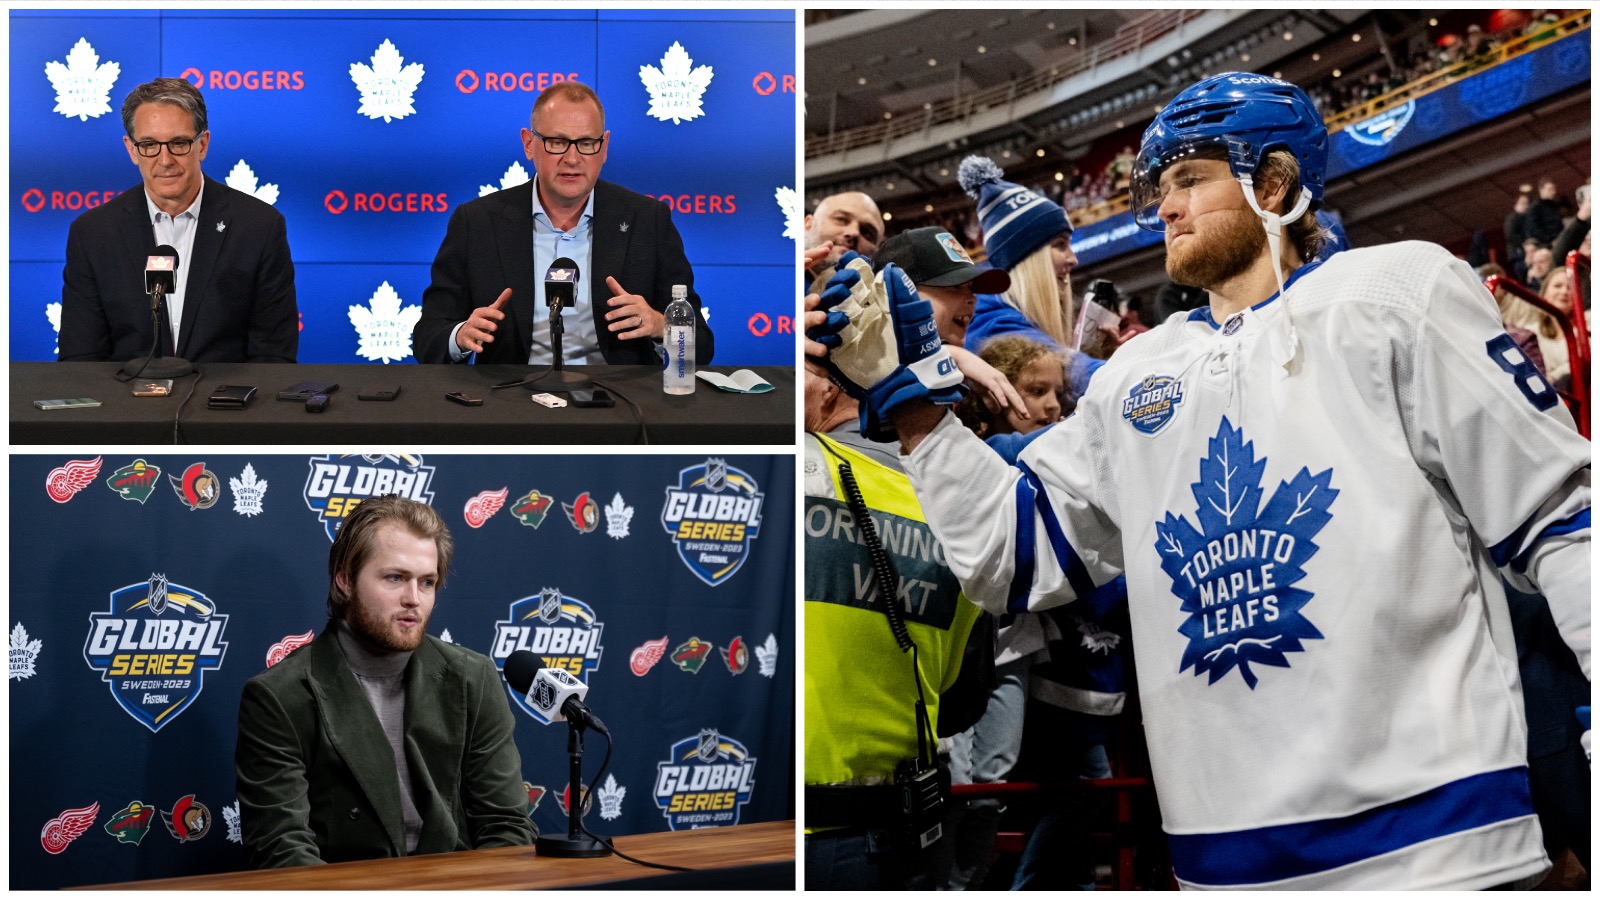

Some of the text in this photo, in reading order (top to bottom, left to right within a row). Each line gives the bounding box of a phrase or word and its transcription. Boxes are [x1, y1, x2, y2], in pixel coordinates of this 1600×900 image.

[209, 70, 304, 90] ROGERS
[655, 79, 699, 92] TORONTO
[662, 91, 691, 99] MAPLE
[662, 100, 691, 108] LEAFS
[51, 190, 124, 211] ROGE
[354, 192, 449, 213] ROGERS
[645, 193, 737, 214] OGERS
[677, 330, 686, 379] smartwater
[1124, 383, 1181, 416] GLOBAL
[1131, 399, 1171, 420] SERIES
[237, 487, 261, 498] TORONTO
[308, 463, 429, 504] GLOBAL
[665, 491, 761, 527] GLOBAL
[677, 521, 746, 541] SERIES
[1180, 529, 1296, 589] TORONTO
[1199, 563, 1277, 609] MAPLE
[1202, 594, 1280, 639] LEAFS
[88, 618, 222, 656] GLOBAL
[494, 626, 600, 659] GLOBAL
[9, 649, 34, 659] ORONTO
[109, 654, 196, 675] SERIES
[657, 763, 752, 797] GLOBAL
[668, 791, 736, 813] SERIES
